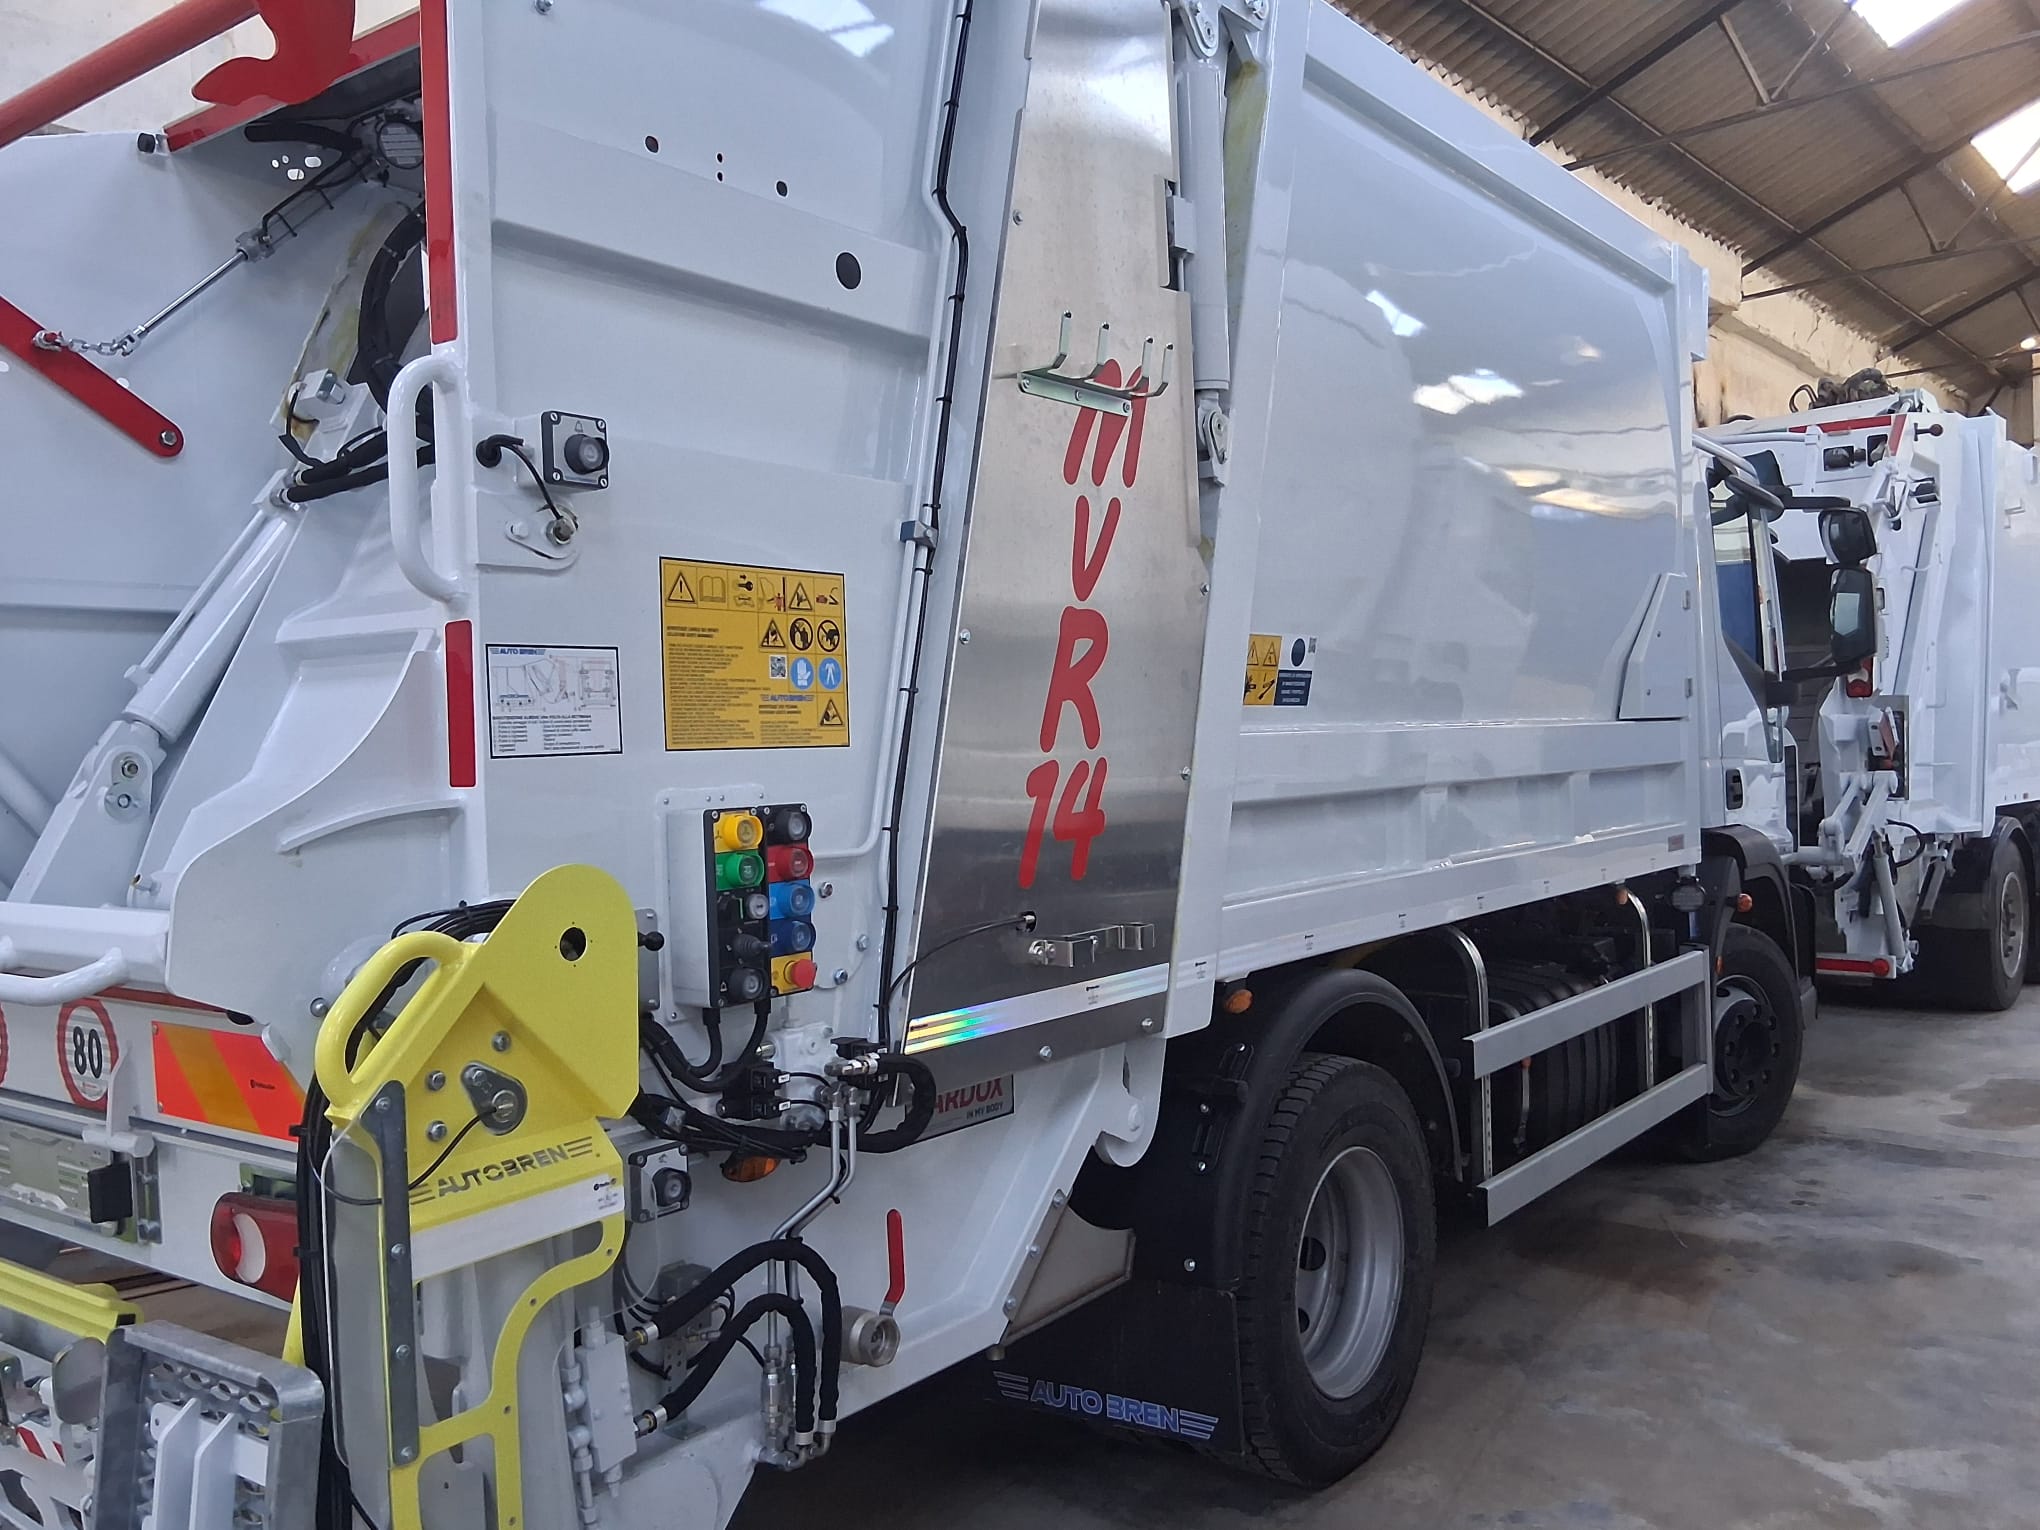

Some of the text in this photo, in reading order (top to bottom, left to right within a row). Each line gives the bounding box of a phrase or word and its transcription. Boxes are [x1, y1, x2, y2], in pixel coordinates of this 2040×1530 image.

[1017, 357, 1148, 888] MVR 14
[73, 1026, 103, 1079] 80
[935, 1078, 1003, 1113] ARDOX
[986, 1102, 1003, 1114] BODY
[1030, 1379, 1179, 1433] AUTO BREN
